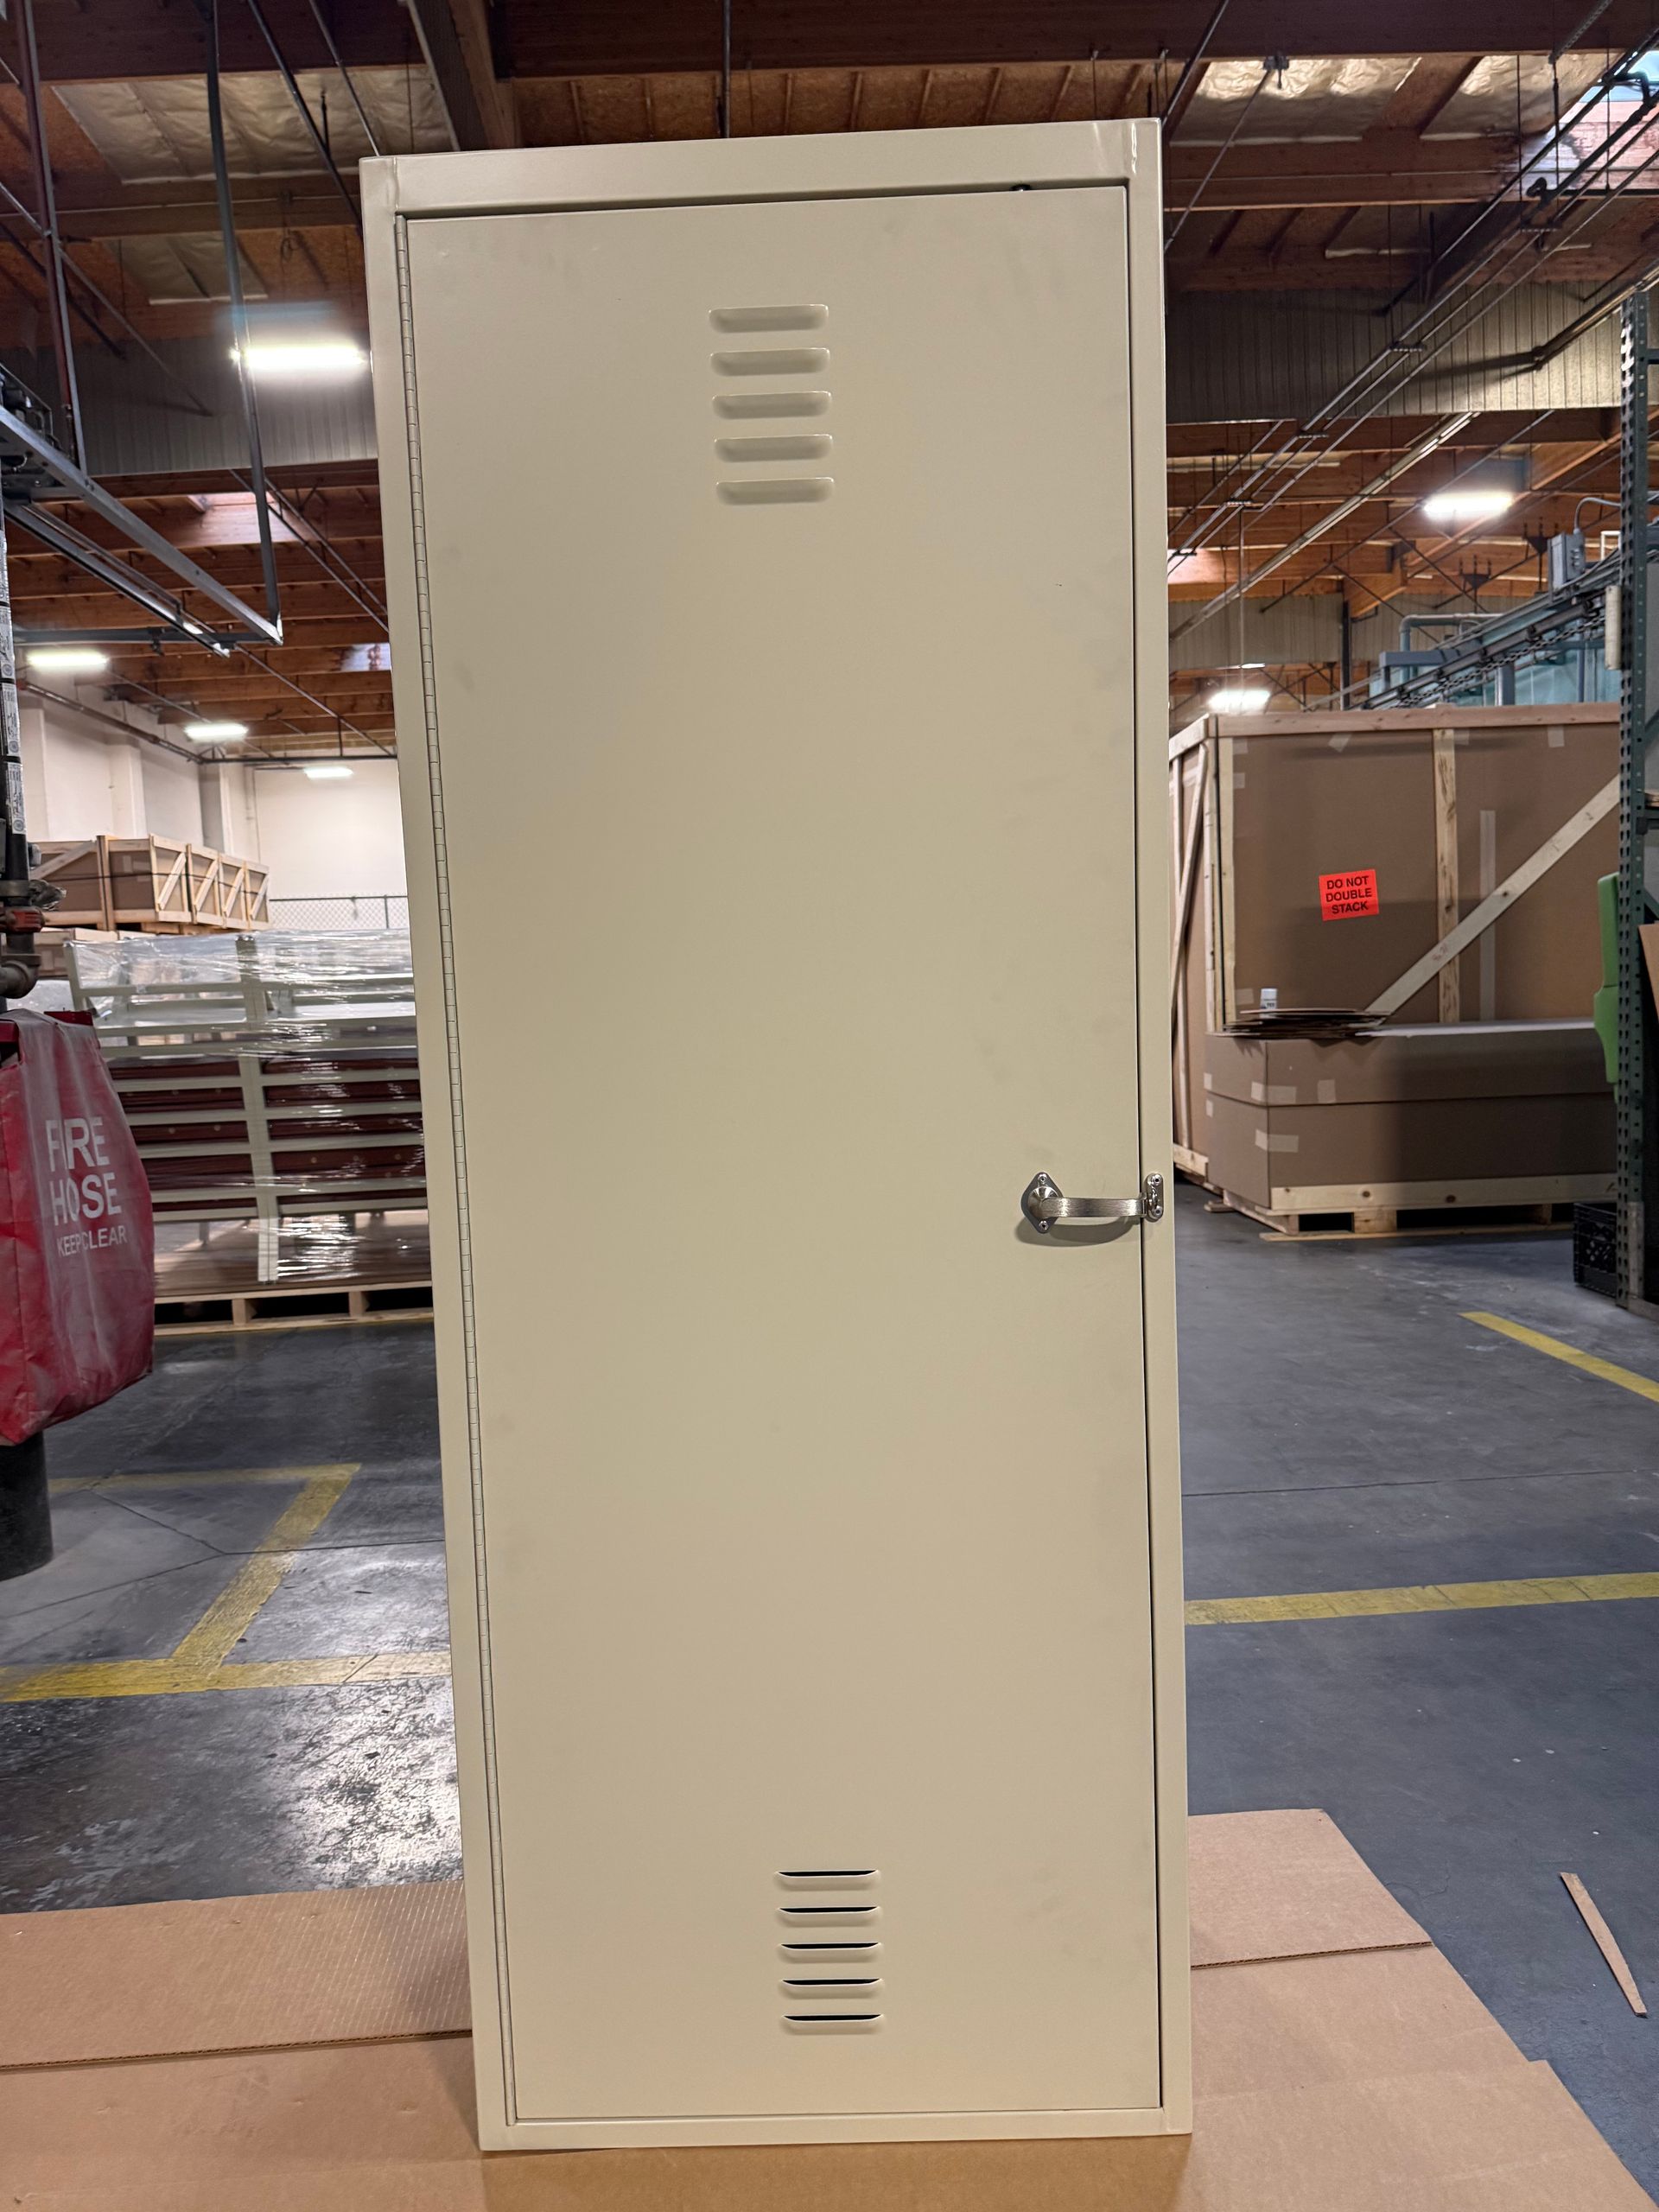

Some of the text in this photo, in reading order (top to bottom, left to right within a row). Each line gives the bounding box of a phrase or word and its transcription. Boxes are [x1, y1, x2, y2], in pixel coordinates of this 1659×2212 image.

[1326, 875, 1369, 889] DO NOT
[1325, 887, 1372, 902] DOUBLE
[1332, 901, 1369, 914] STACK
[46, 1116, 110, 1172] FIRE
[49, 1173, 122, 1226] HOSE
[56, 1225, 127, 1256] KEEP CLEAR
